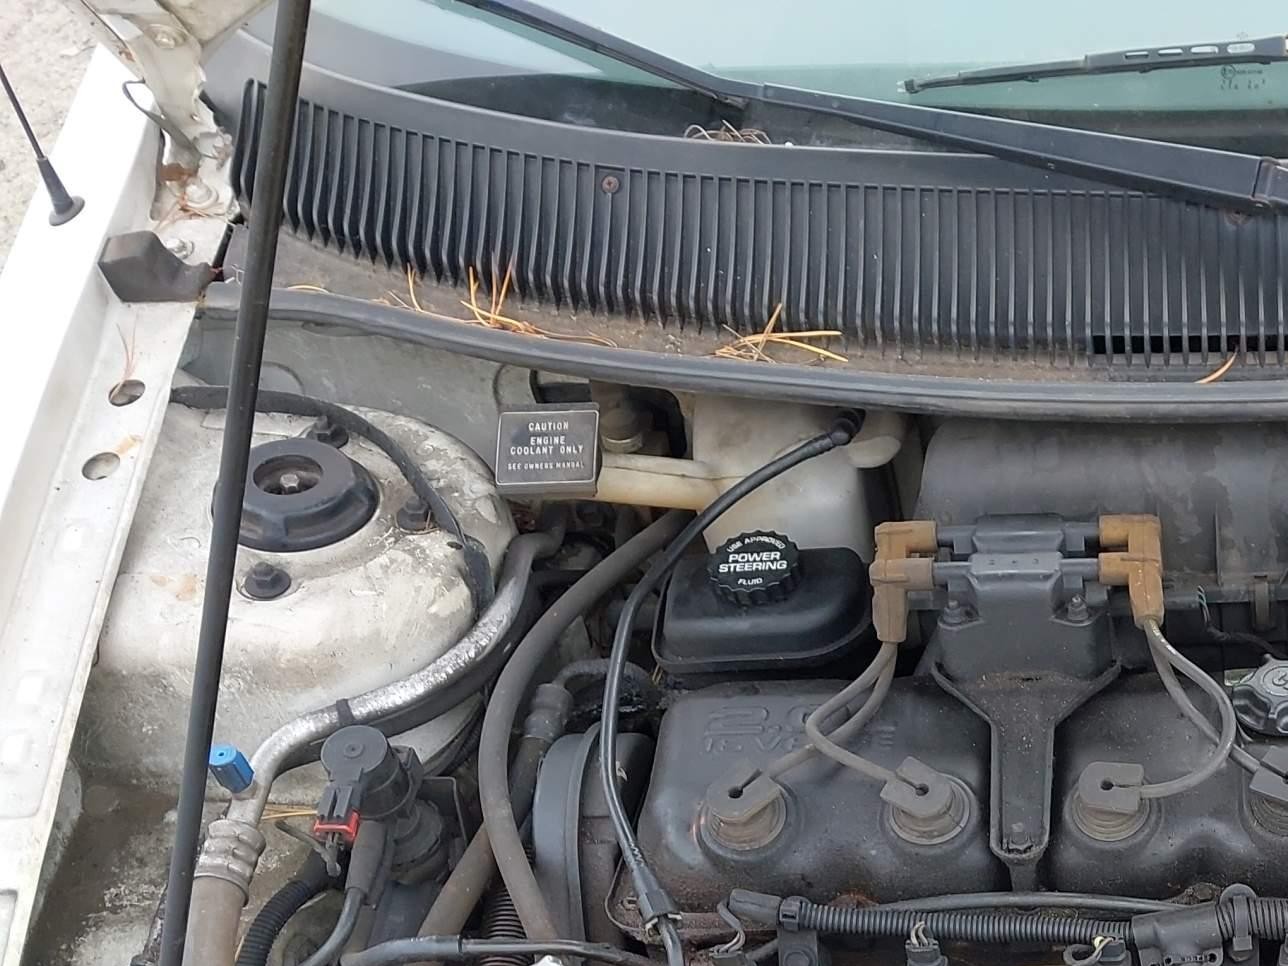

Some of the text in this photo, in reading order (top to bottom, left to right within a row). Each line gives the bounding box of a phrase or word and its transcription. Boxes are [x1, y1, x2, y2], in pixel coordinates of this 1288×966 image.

[528, 421, 569, 431] CAUTION
[530, 436, 566, 445] ENGINE
[510, 445, 583, 455] COOLANT ONLY
[726, 536, 786, 552] USE APPROVED
[728, 551, 780, 562] POWER
[718, 560, 787, 573] STEERING
[737, 577, 763, 585] FLUID
